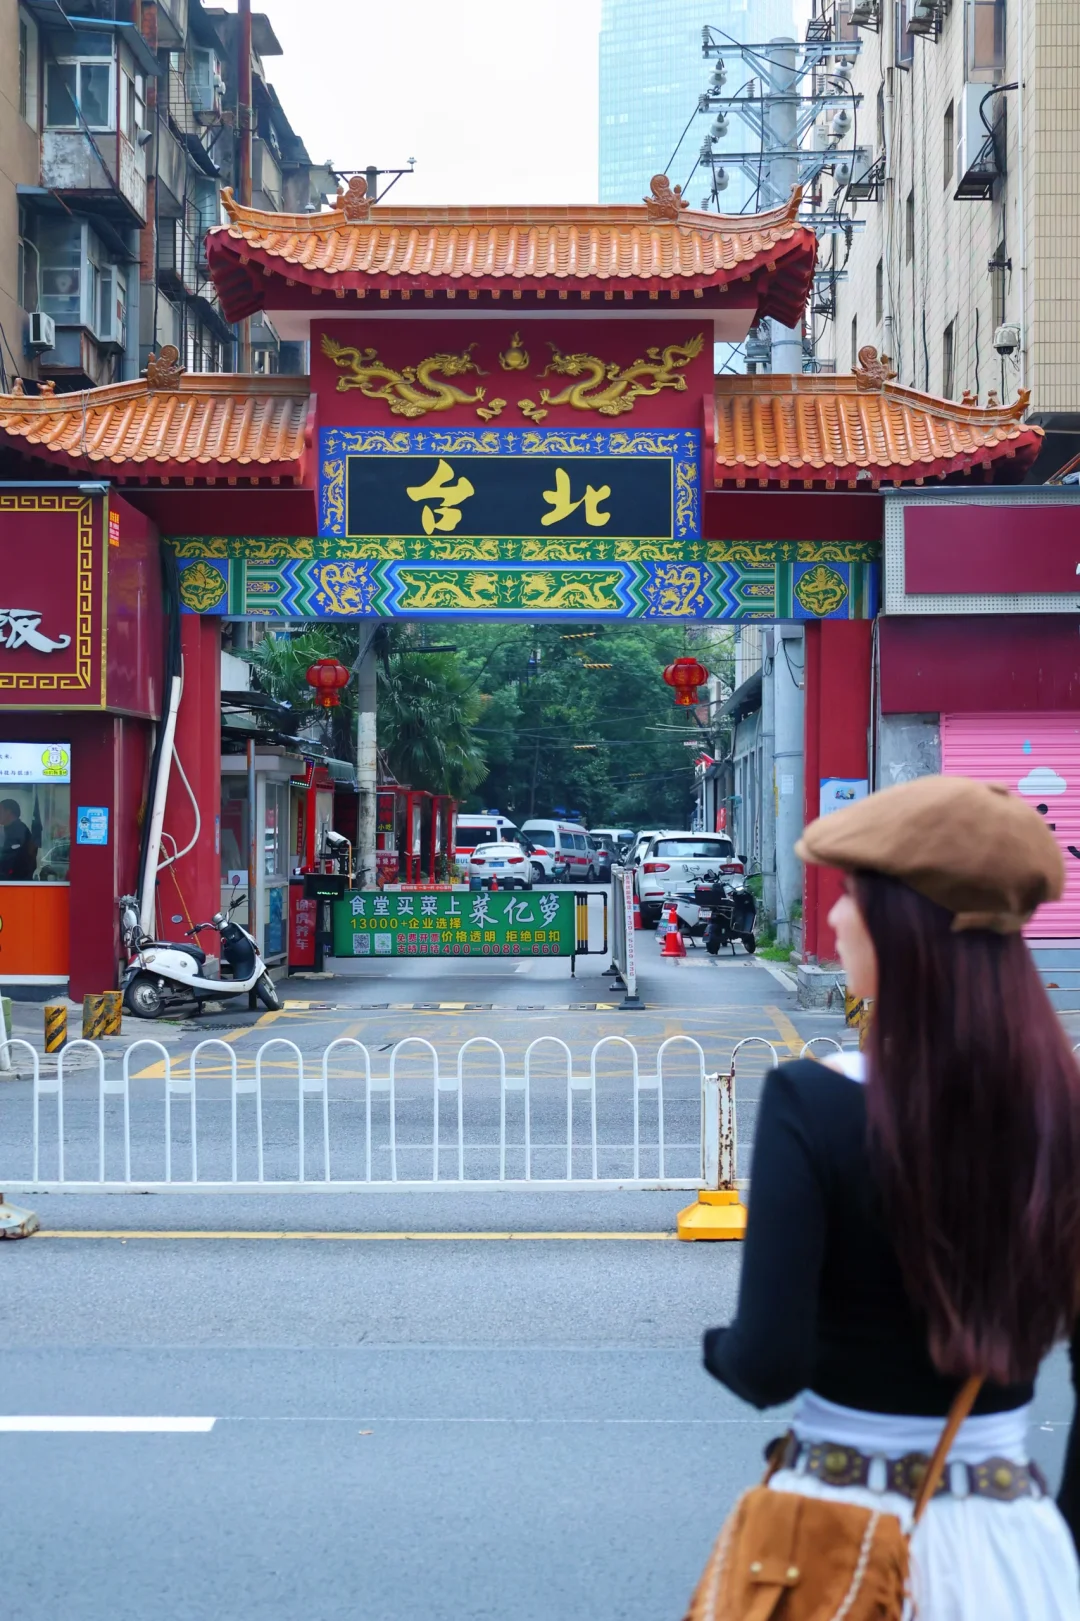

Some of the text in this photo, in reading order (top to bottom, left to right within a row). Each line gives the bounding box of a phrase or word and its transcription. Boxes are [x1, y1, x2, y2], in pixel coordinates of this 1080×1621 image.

[406, 458, 611, 535] 台北
[349, 895, 462, 916] 食堂买菜上
[396, 933, 440, 944] 免费开票
[441, 930, 561, 943] 价格透明 拒绝回扣
[396, 944, 440, 955] 支持月结
[442, 944, 561, 955] 400-0088-660
